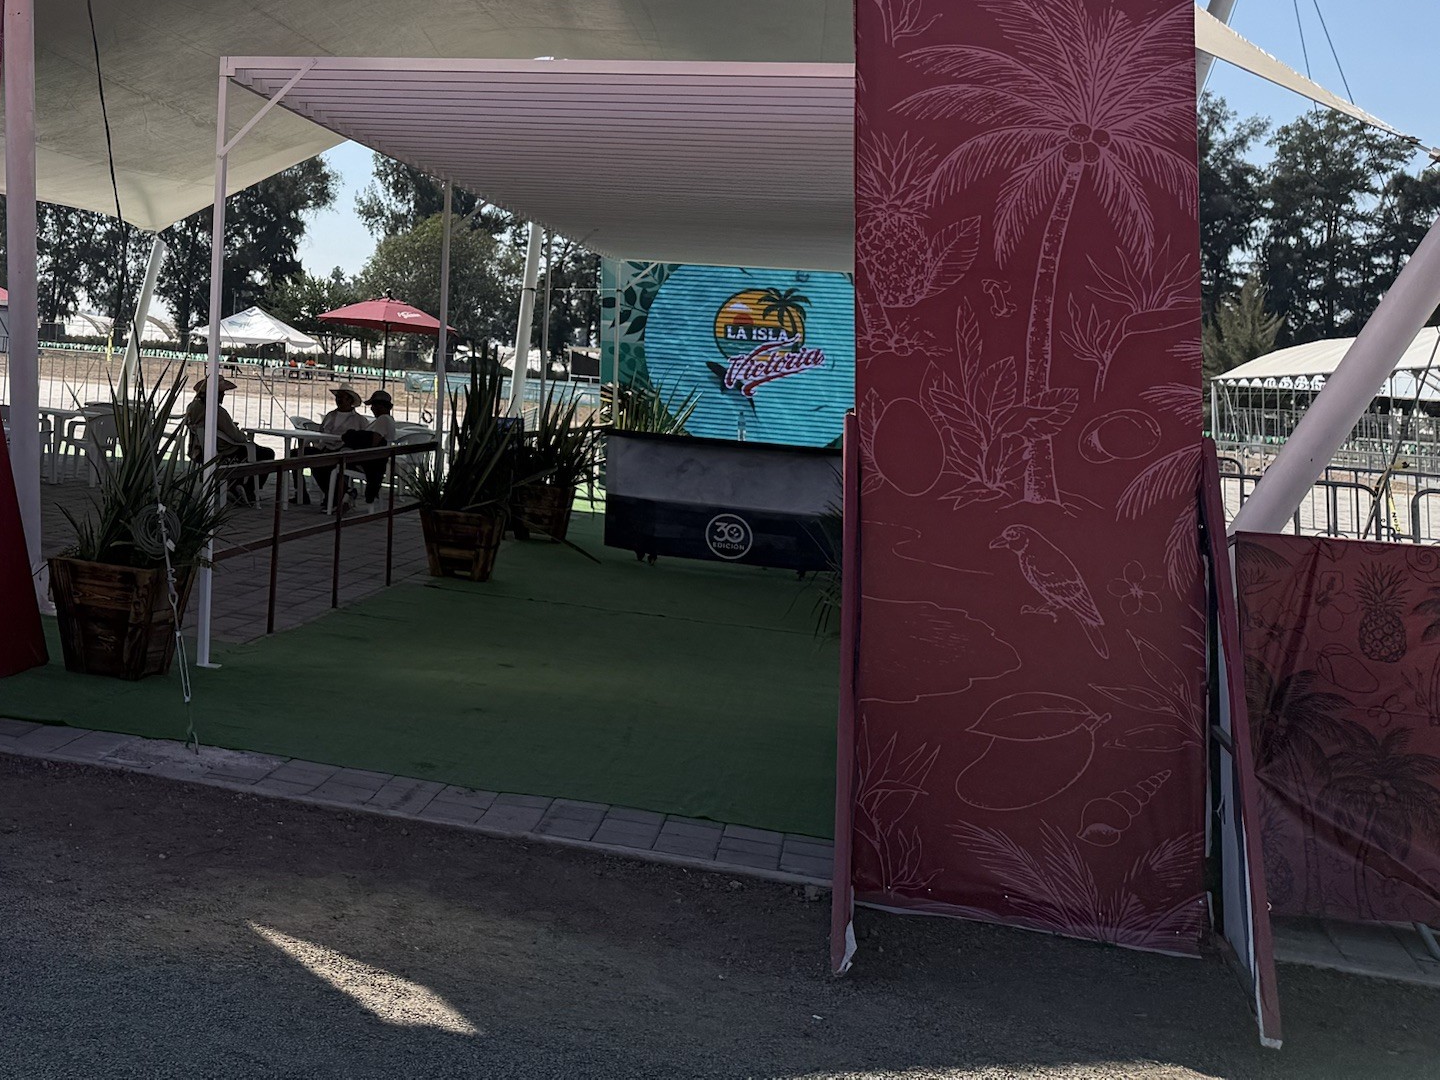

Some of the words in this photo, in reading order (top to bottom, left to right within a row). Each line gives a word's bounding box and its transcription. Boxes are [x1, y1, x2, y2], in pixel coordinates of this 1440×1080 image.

[726, 325, 748, 340] LA
[751, 327, 789, 341] ISLA
[725, 336, 825, 397] Victoria
[713, 522, 745, 543] 30
